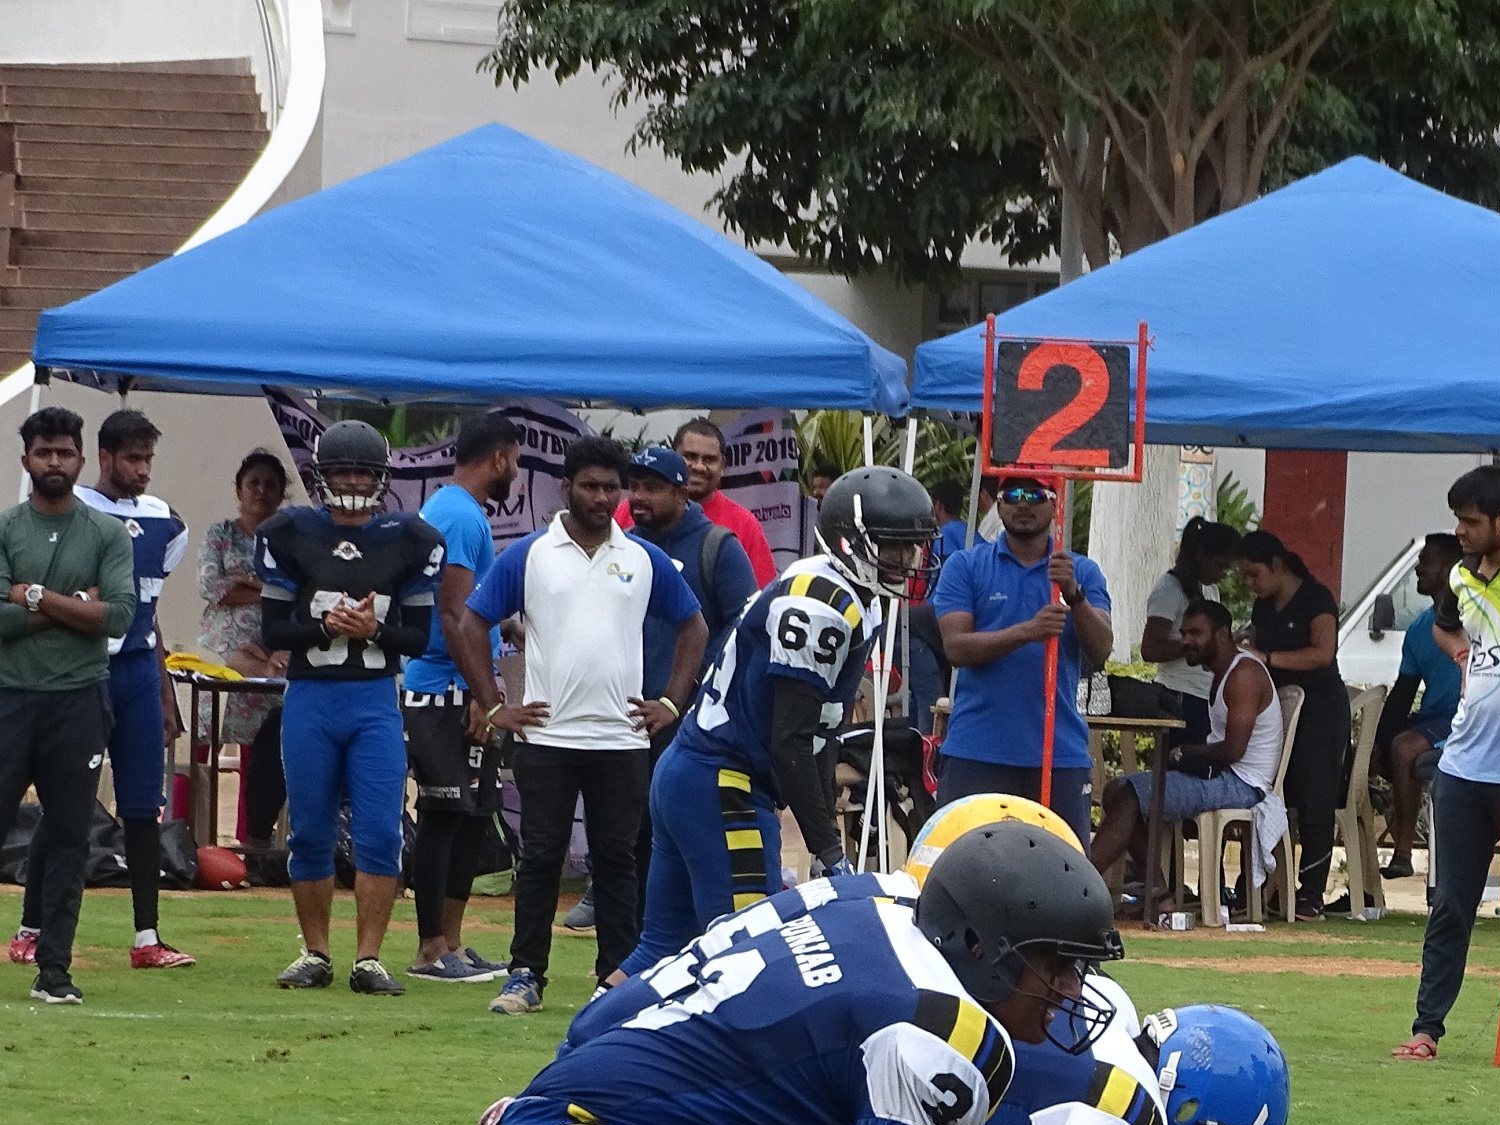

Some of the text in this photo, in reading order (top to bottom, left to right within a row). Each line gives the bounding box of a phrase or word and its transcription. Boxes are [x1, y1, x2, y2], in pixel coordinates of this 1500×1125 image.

[1017, 342, 1110, 467] 2
[755, 437, 799, 464] 2019
[778, 607, 846, 665] 69
[780, 914, 843, 989] PUNJAB
